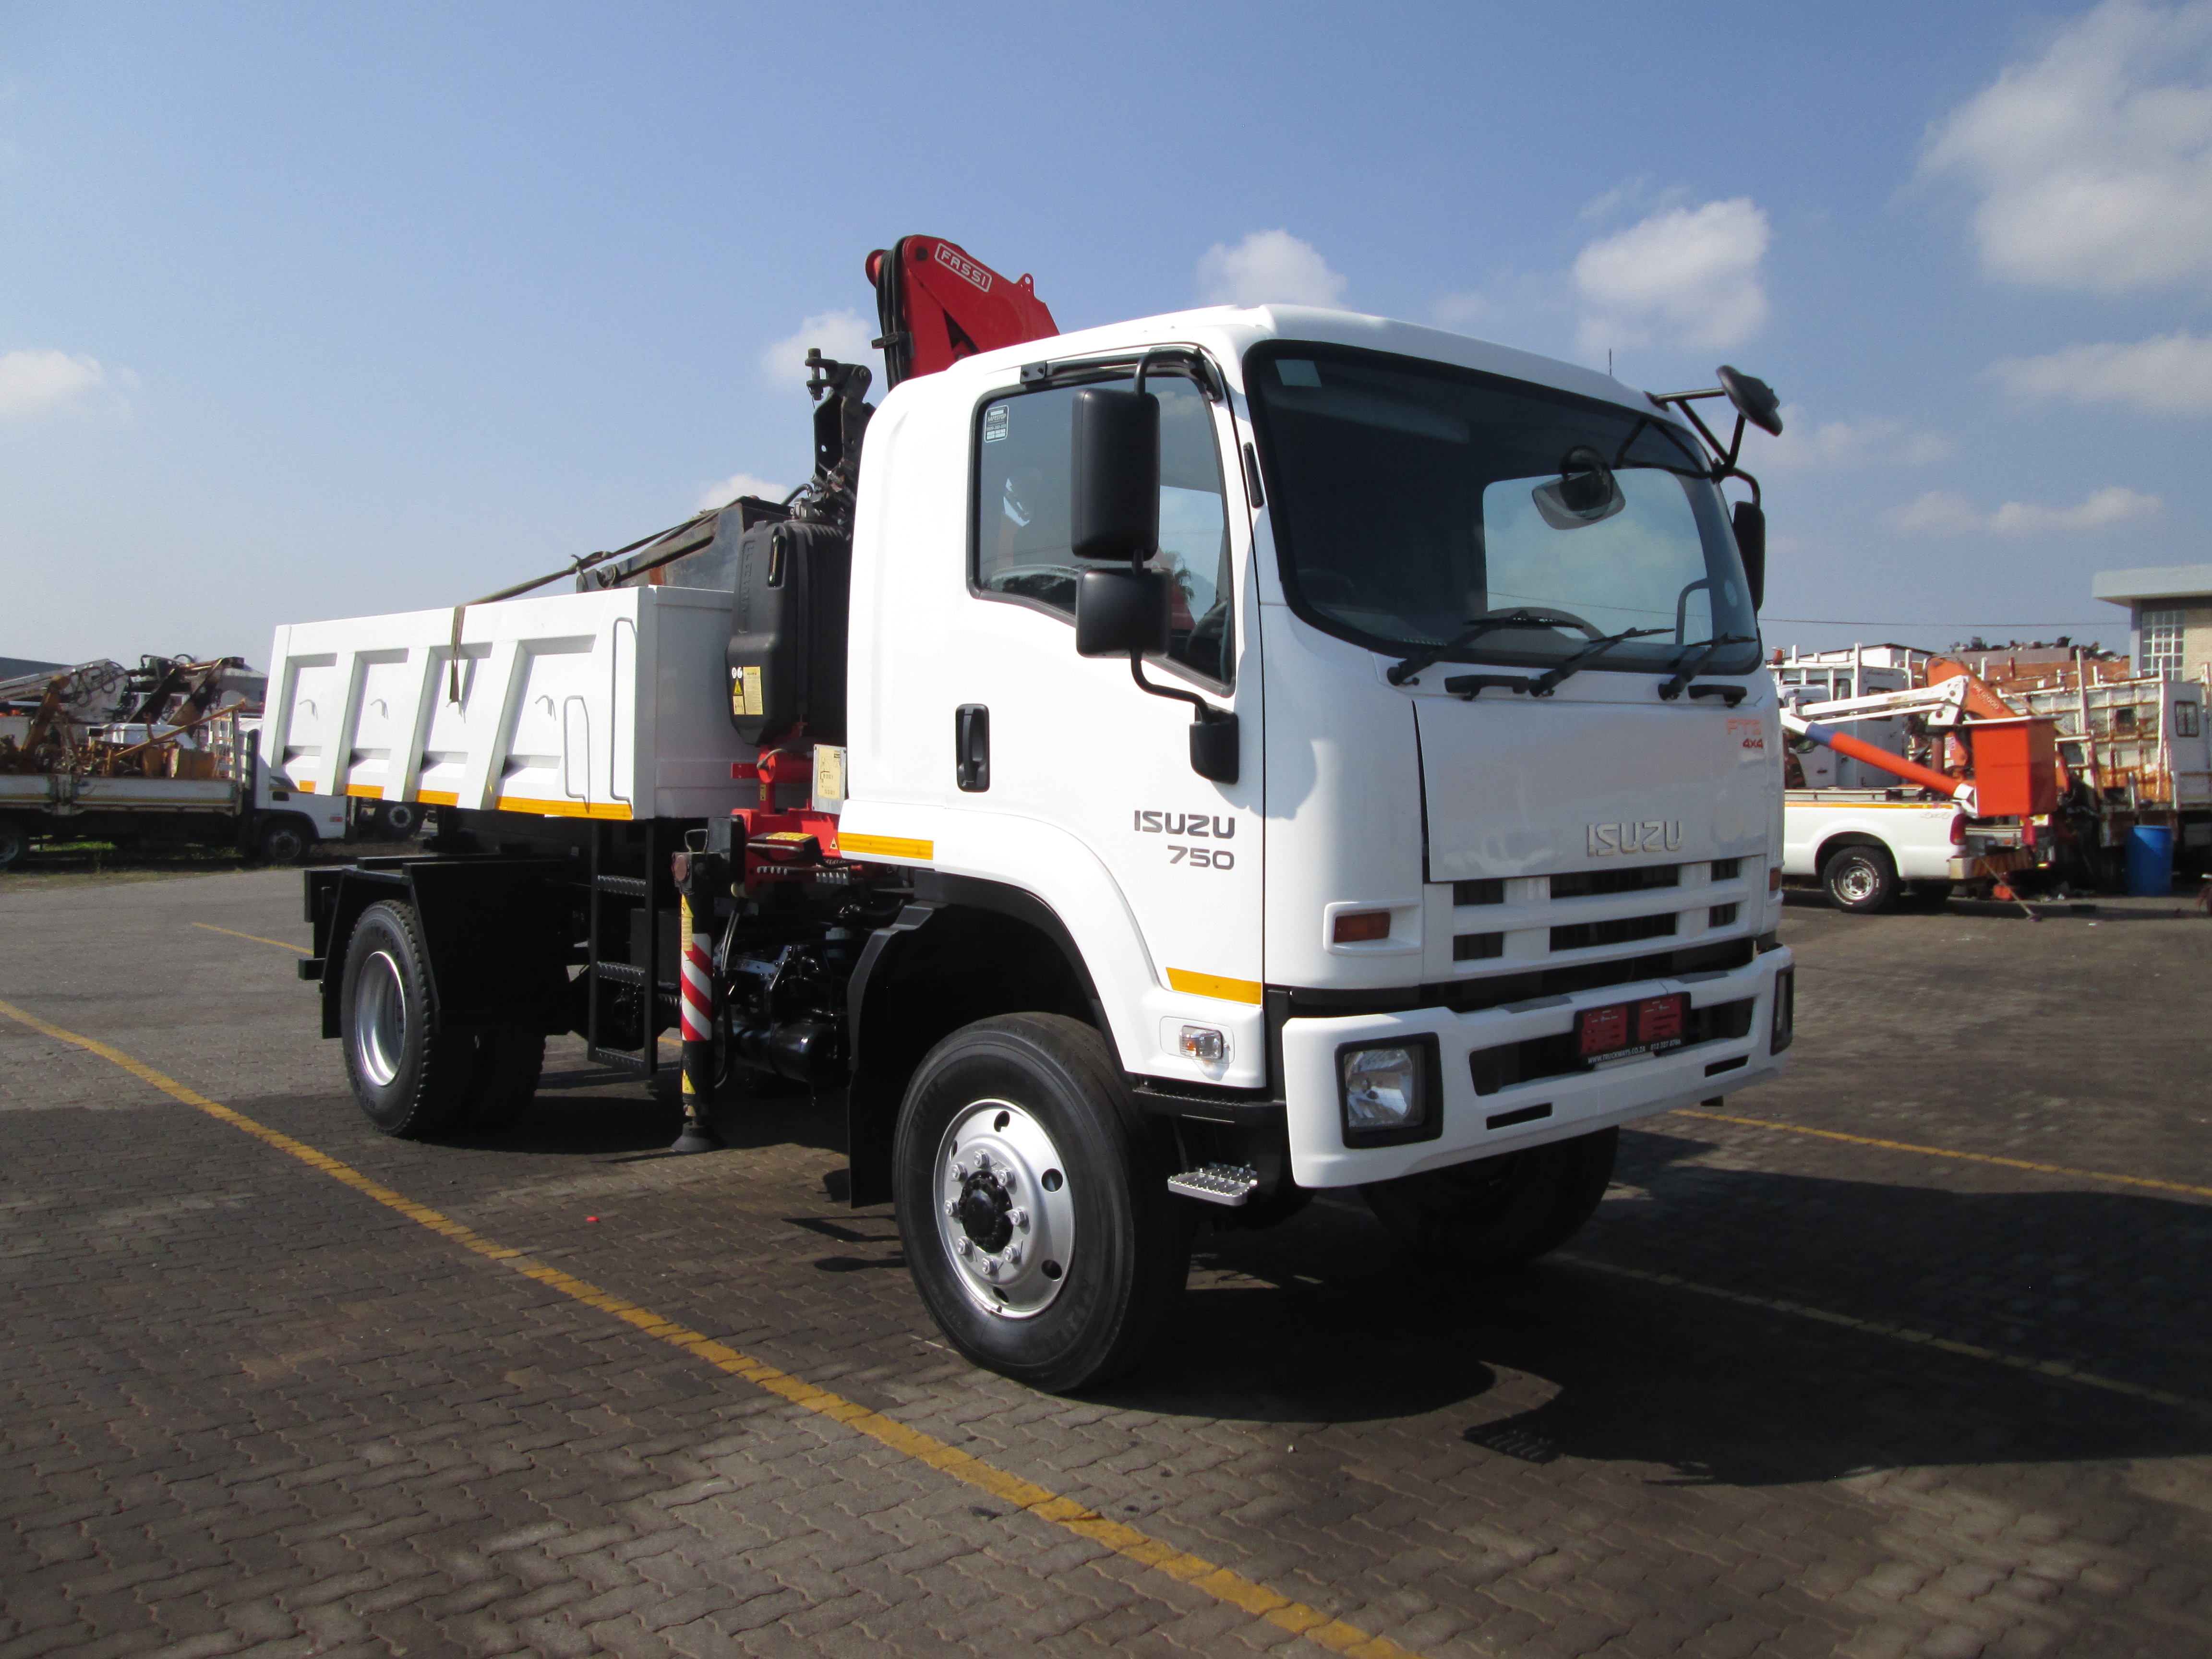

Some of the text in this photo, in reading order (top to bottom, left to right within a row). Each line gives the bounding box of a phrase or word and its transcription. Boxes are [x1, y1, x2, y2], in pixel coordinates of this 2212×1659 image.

[941, 250, 986, 286] FASSI
[1134, 810, 1235, 839] ISUZU
[1587, 820, 1682, 857] ISUZU
[1167, 844, 1235, 870] 750
